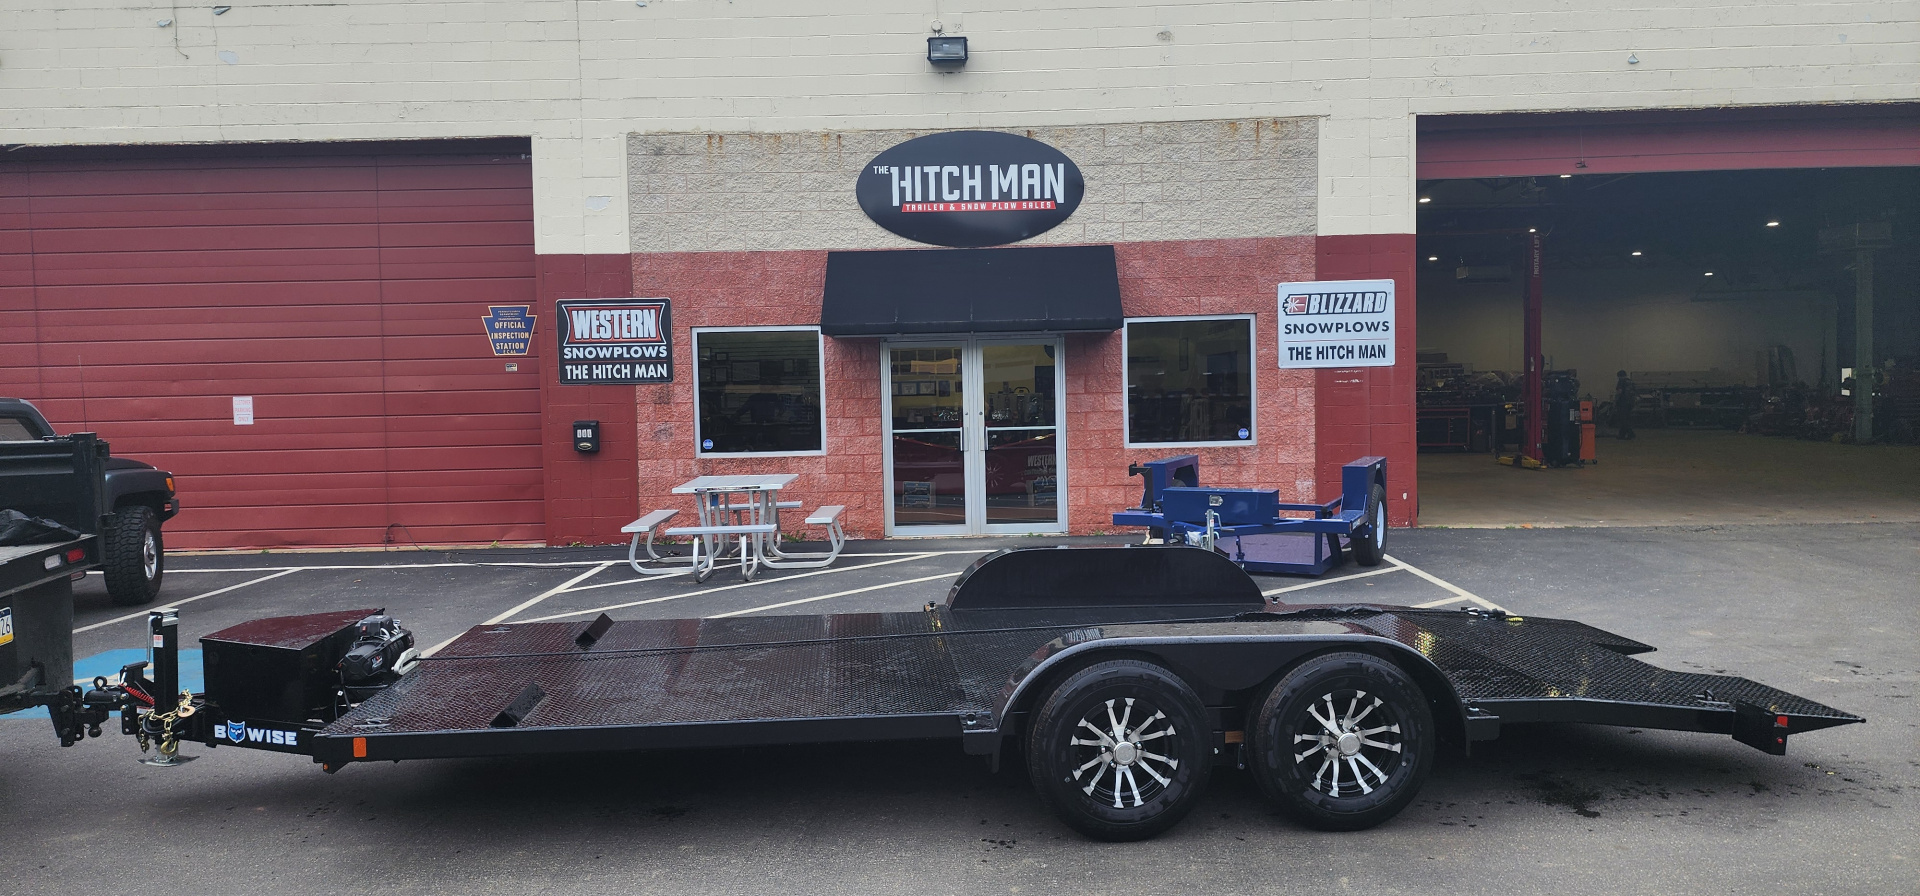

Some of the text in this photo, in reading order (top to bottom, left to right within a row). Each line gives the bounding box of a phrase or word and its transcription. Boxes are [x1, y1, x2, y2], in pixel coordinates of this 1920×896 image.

[873, 163, 1064, 206] THE HITCH MAN
[906, 203, 944, 211] TRAILER
[992, 202, 1017, 210] PLOW
[1022, 201, 1051, 209] SALES
[1308, 291, 1386, 314] BLIZZARD
[494, 321, 526, 329] OFFICIAL
[572, 309, 656, 340] WESTERN
[1284, 321, 1390, 335] SNOWPLOWS
[495, 342, 525, 350] STATION
[563, 346, 668, 360] SNOWPLOWS
[1288, 344, 1386, 361] THE HITCH MAN
[565, 363, 668, 380] THE HITCH MAN
